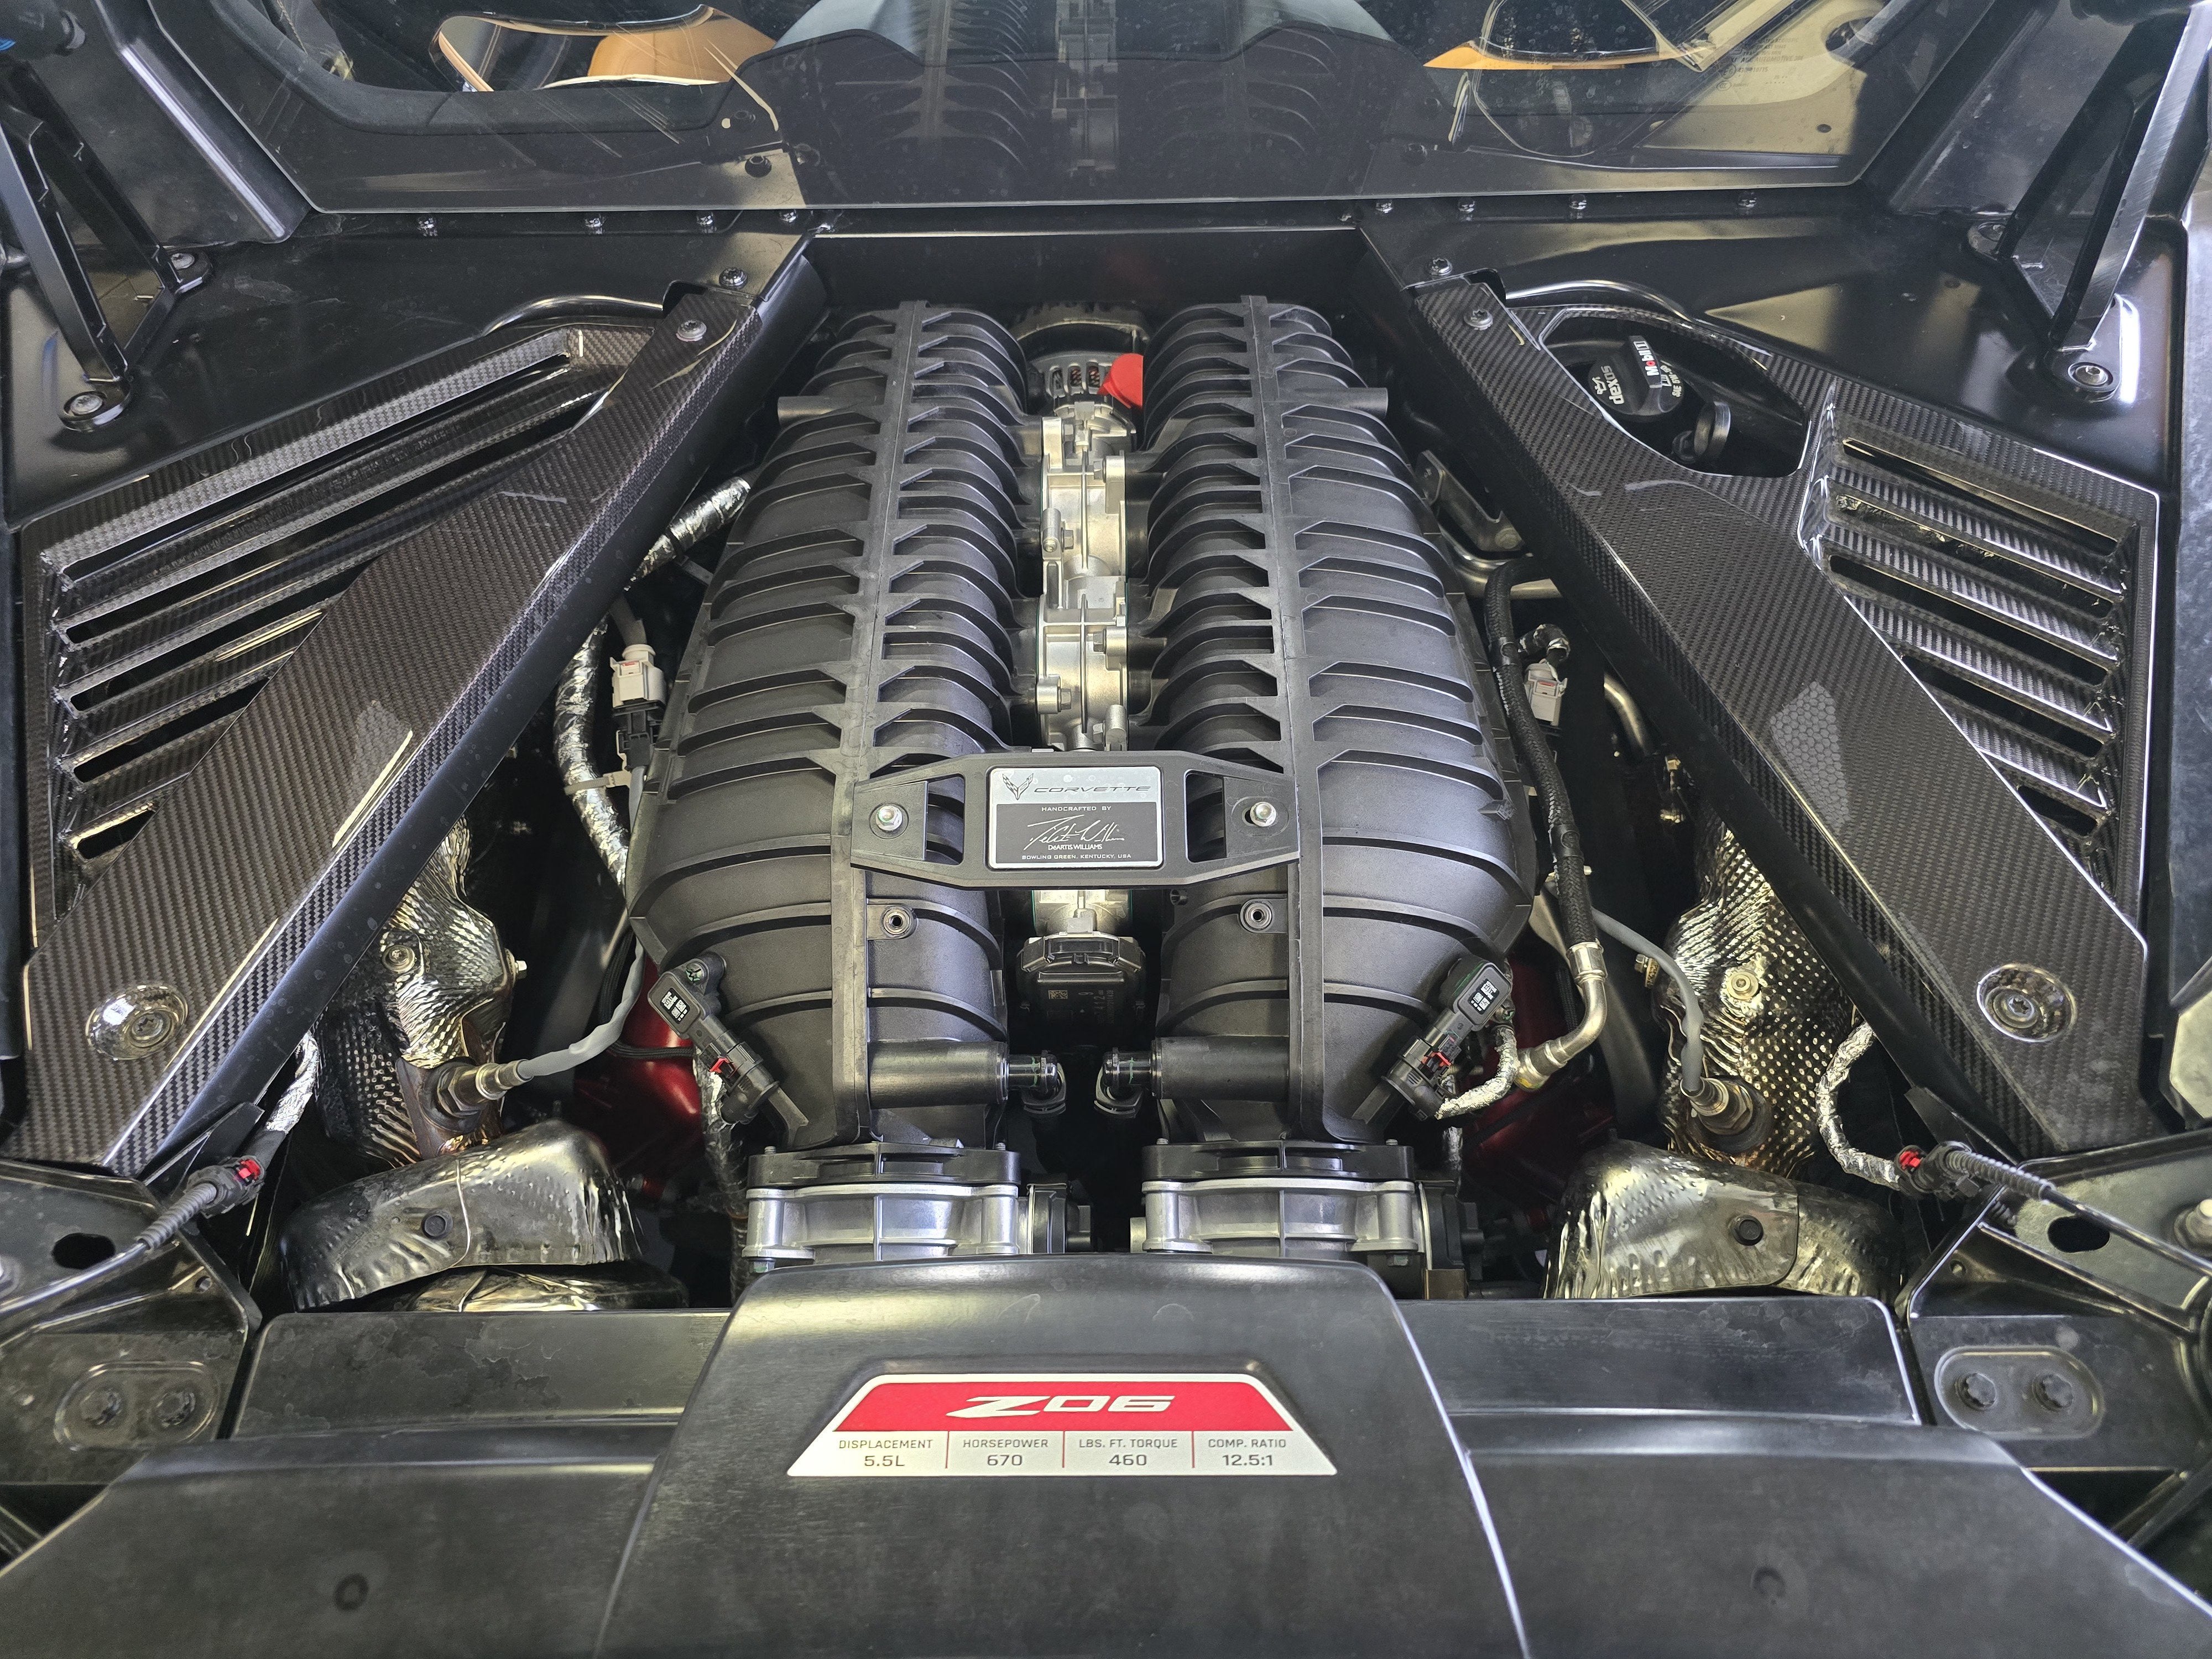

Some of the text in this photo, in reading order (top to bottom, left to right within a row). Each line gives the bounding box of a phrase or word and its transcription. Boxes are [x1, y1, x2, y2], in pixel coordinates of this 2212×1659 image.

[1600, 365, 1625, 405] dexos
[1672, 385, 1682, 398] SAE
[946, 1395, 1175, 1418] Z06
[839, 1439, 933, 1449] DISPLACEMENT
[963, 1439, 1048, 1448] HORSEPOWER
[1079, 1439, 1178, 1449] LBS. FT. TORQUE
[1208, 1439, 1287, 1448] COMP. RATIO
[864, 1455, 905, 1467] 5.5L
[987, 1454, 1022, 1466] 670
[1108, 1454, 1147, 1466] 460
[1222, 1454, 1272, 1466] 12.5:1
